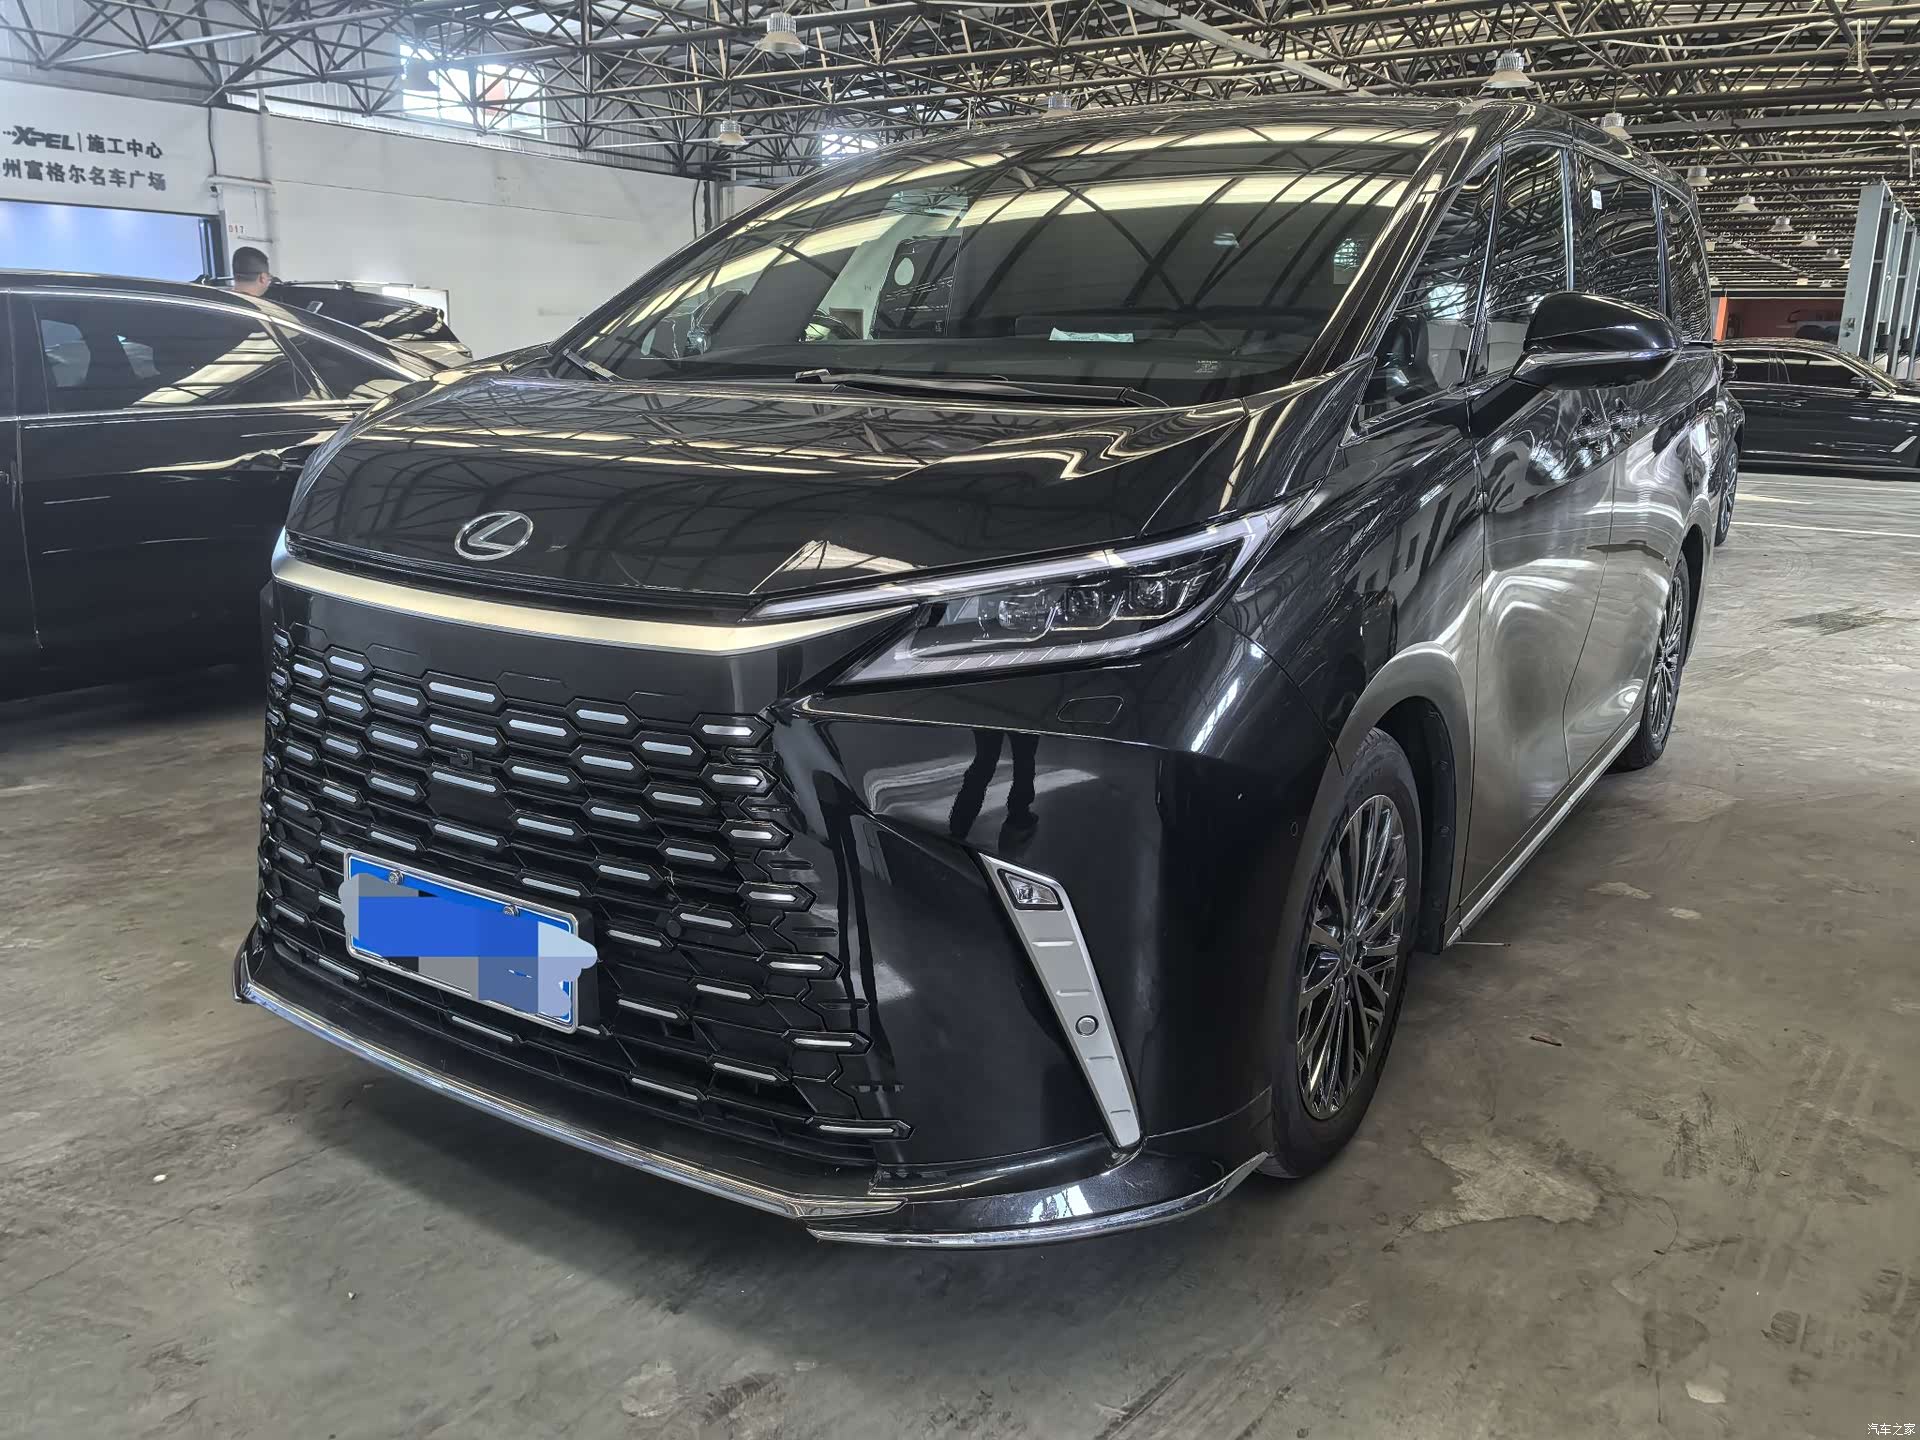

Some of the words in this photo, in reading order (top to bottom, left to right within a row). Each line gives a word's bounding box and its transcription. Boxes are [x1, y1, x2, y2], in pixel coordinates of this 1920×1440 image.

[11, 125, 75, 151] XPEL
[86, 133, 163, 159] 施工中心
[2, 158, 166, 191] 州富格尔名车广场
